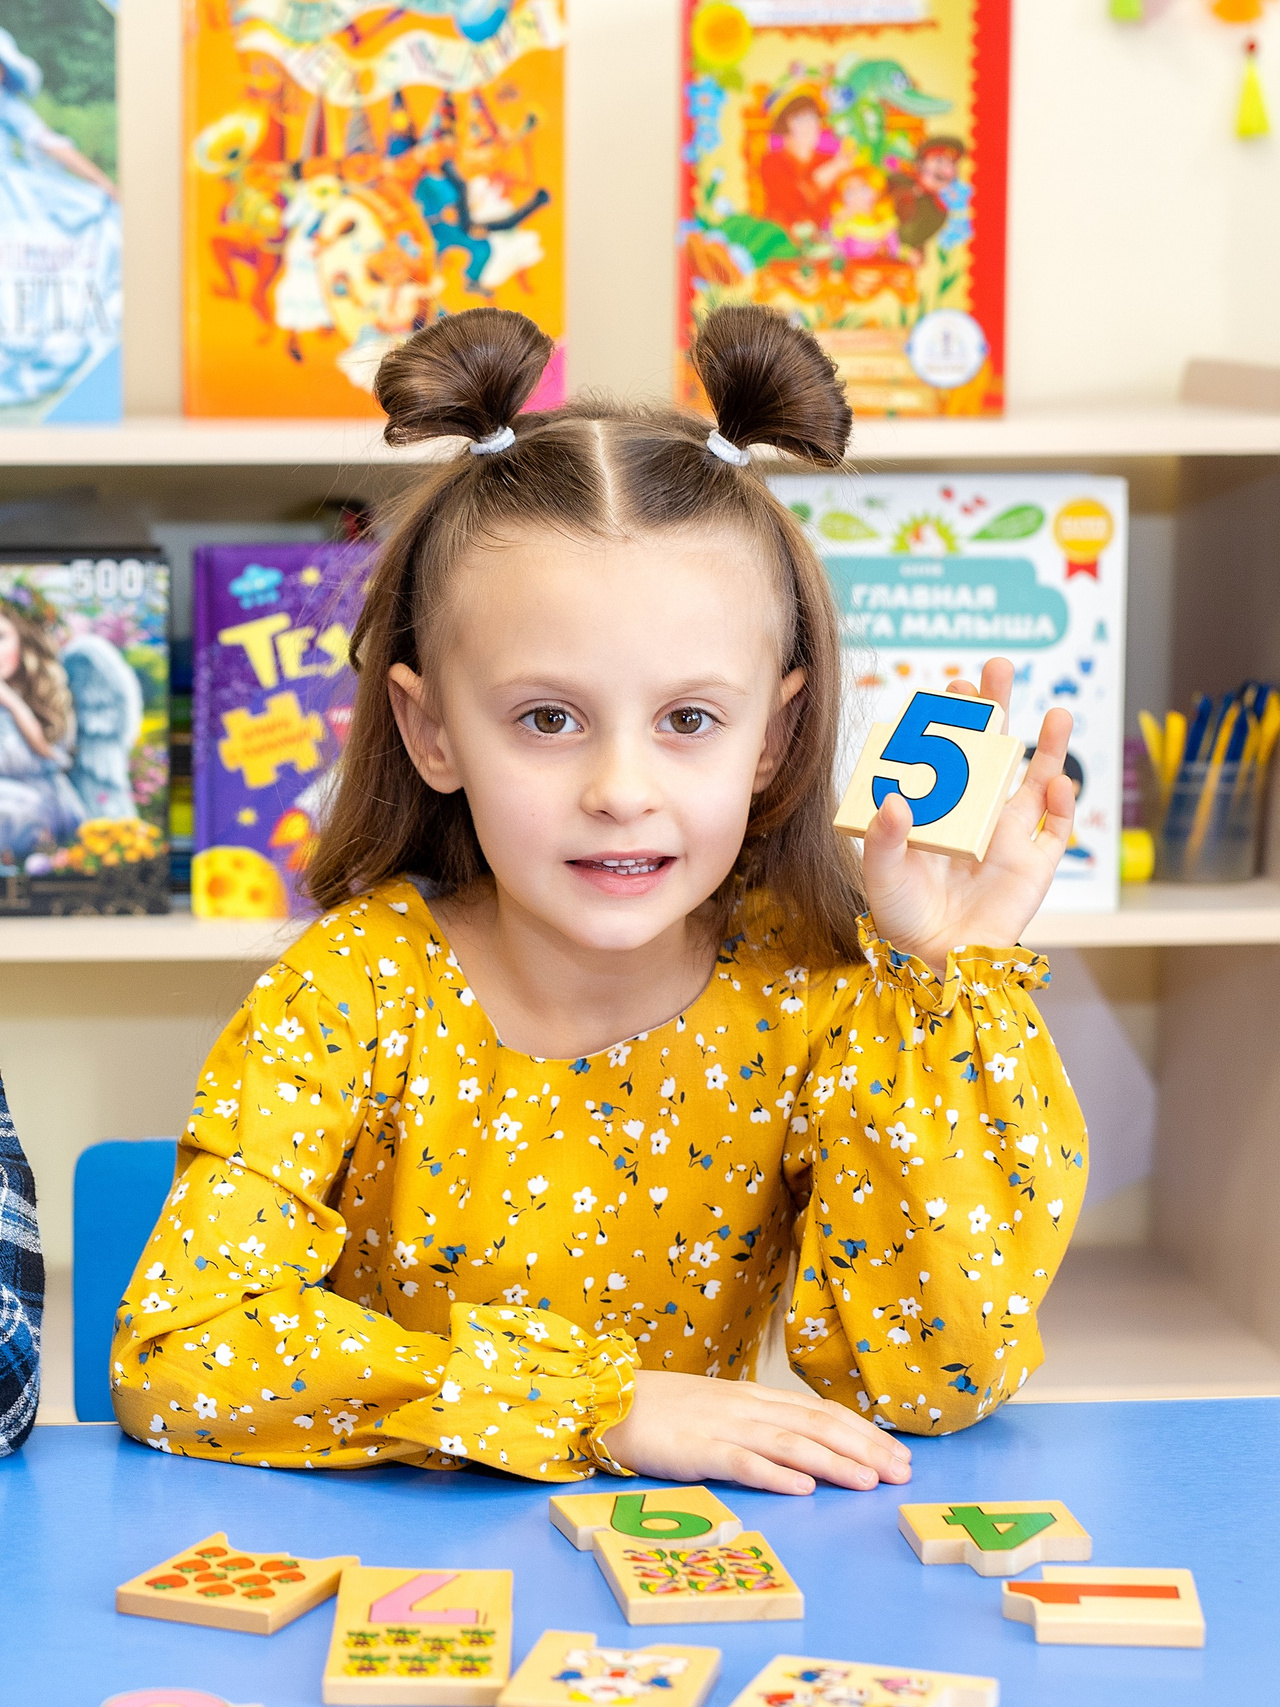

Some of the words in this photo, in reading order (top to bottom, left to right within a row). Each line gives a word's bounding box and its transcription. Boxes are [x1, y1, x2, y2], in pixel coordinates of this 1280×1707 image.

[70, 558, 144, 599] 500
[851, 584, 997, 611] ГЛАВНАЯ
[900, 613, 1057, 639] МАЛЫША
[872, 691, 994, 826] 5
[942, 1506, 1057, 1551] 4
[368, 1573, 478, 1624] 7
